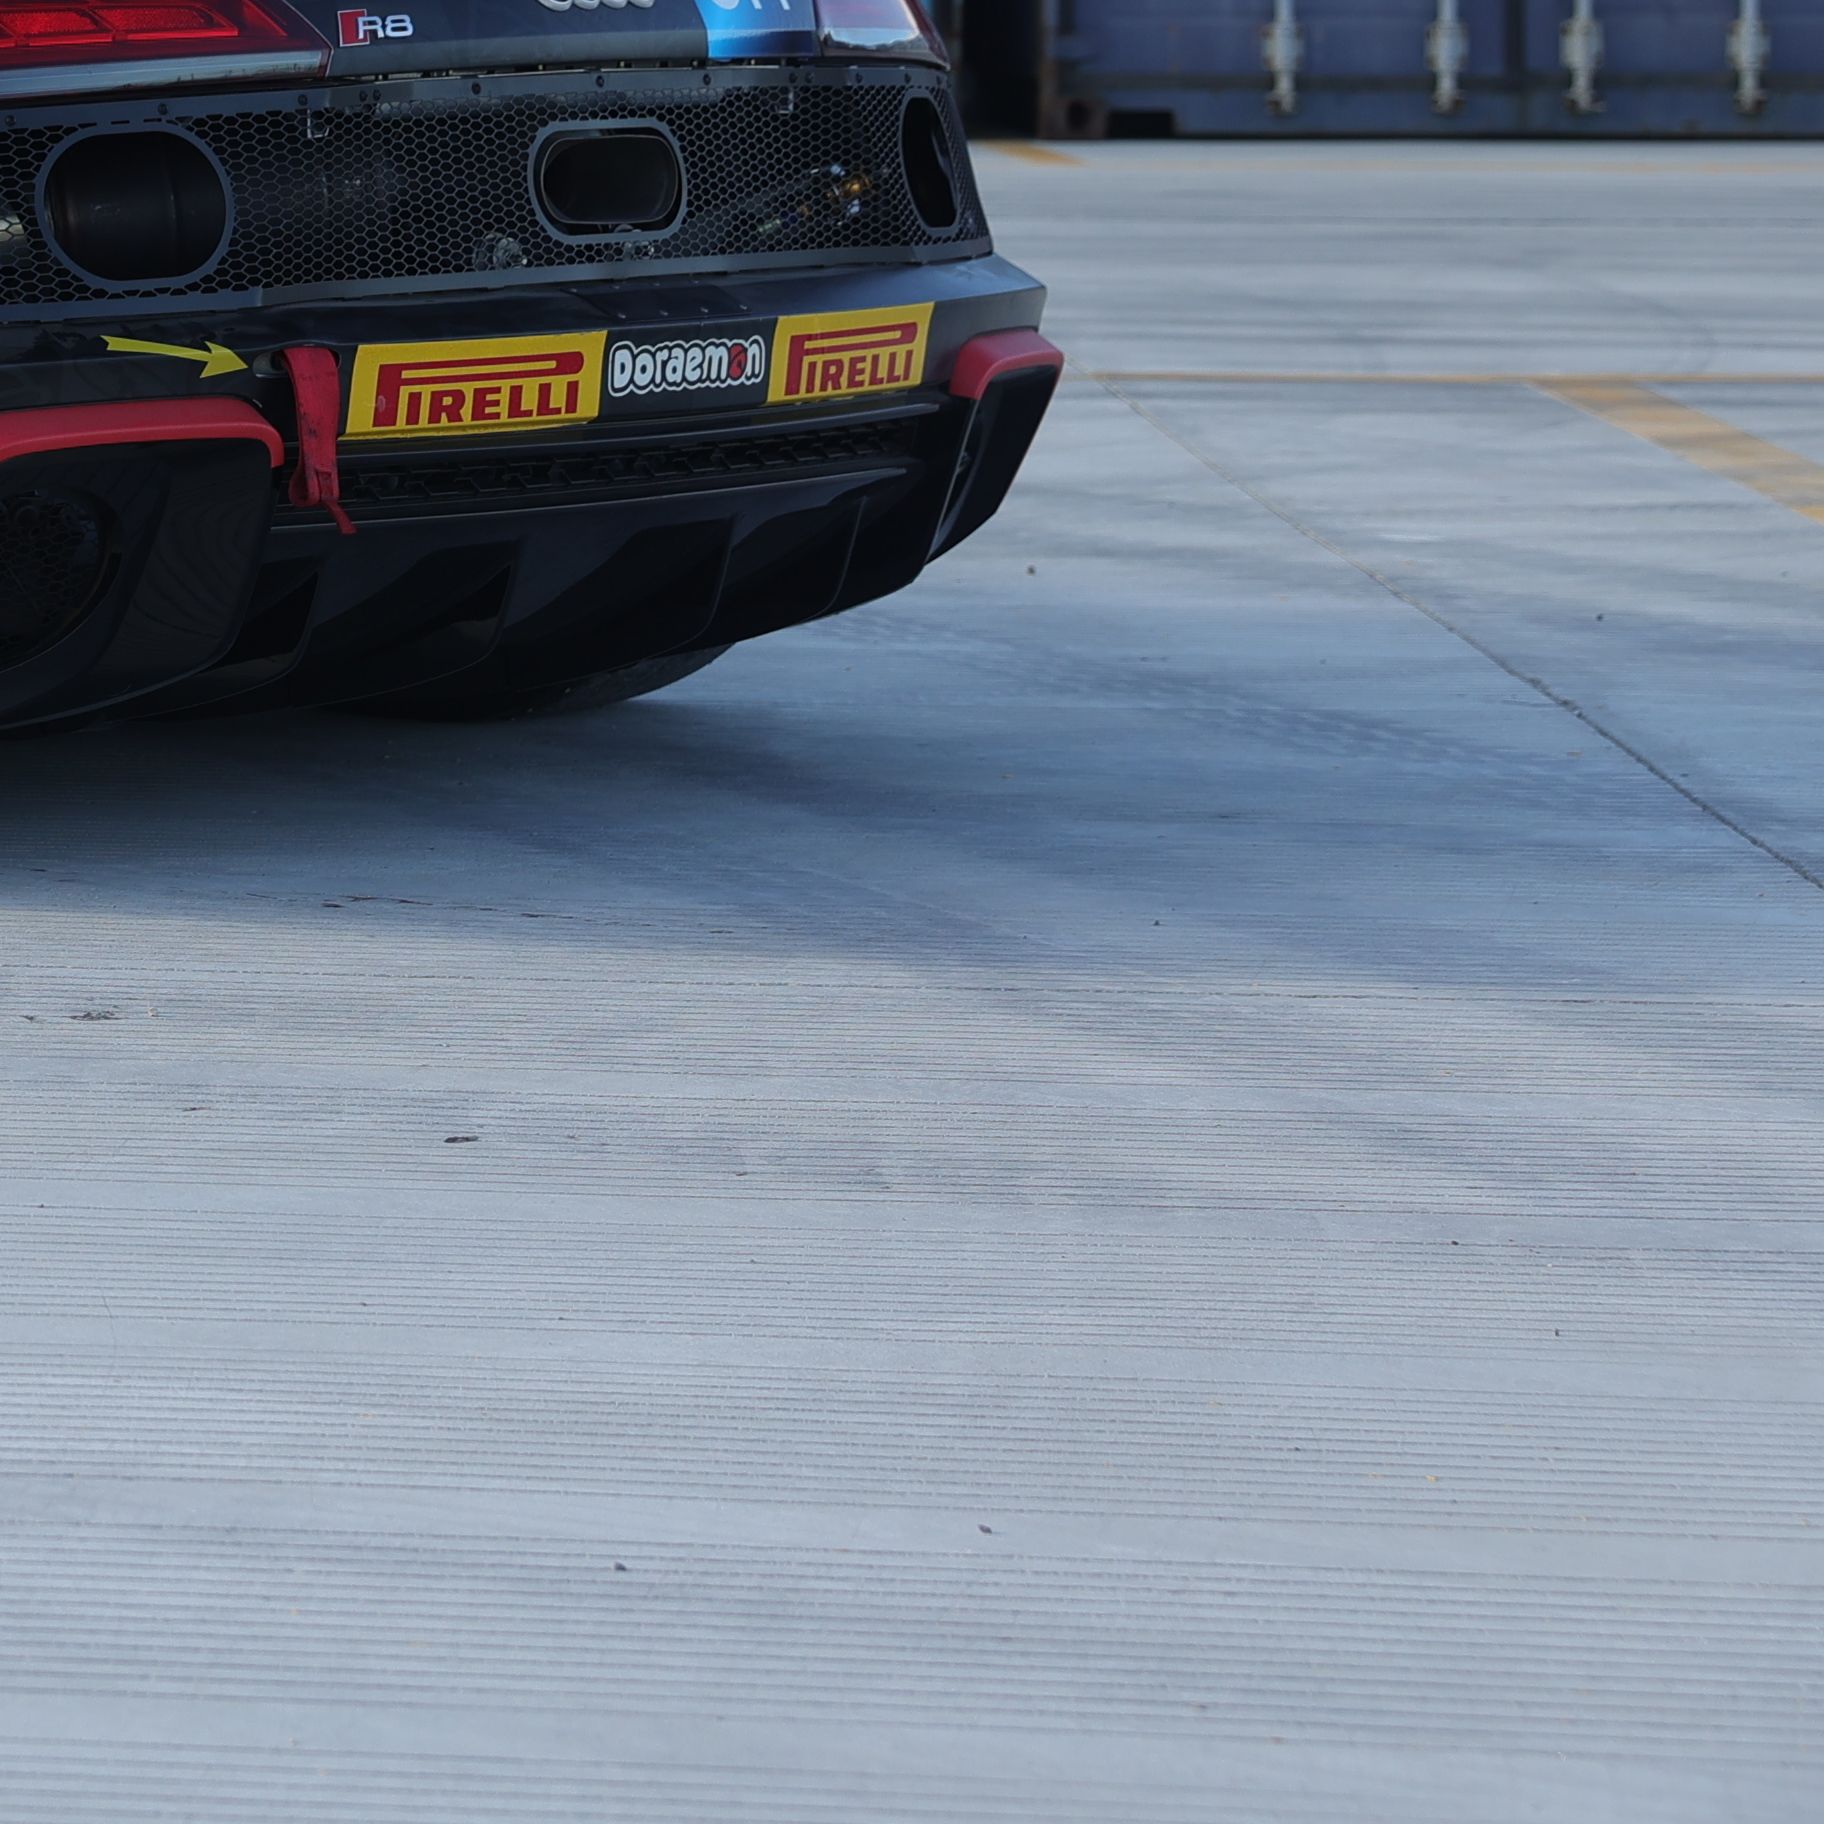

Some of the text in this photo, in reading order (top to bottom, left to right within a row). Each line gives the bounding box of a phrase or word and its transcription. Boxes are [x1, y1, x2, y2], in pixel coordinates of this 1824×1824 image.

[356, 13, 414, 40] R8
[372, 350, 586, 428] PIRELLI
[610, 336, 765, 396] Doraemon
[783, 321, 919, 397] PIRELLI
